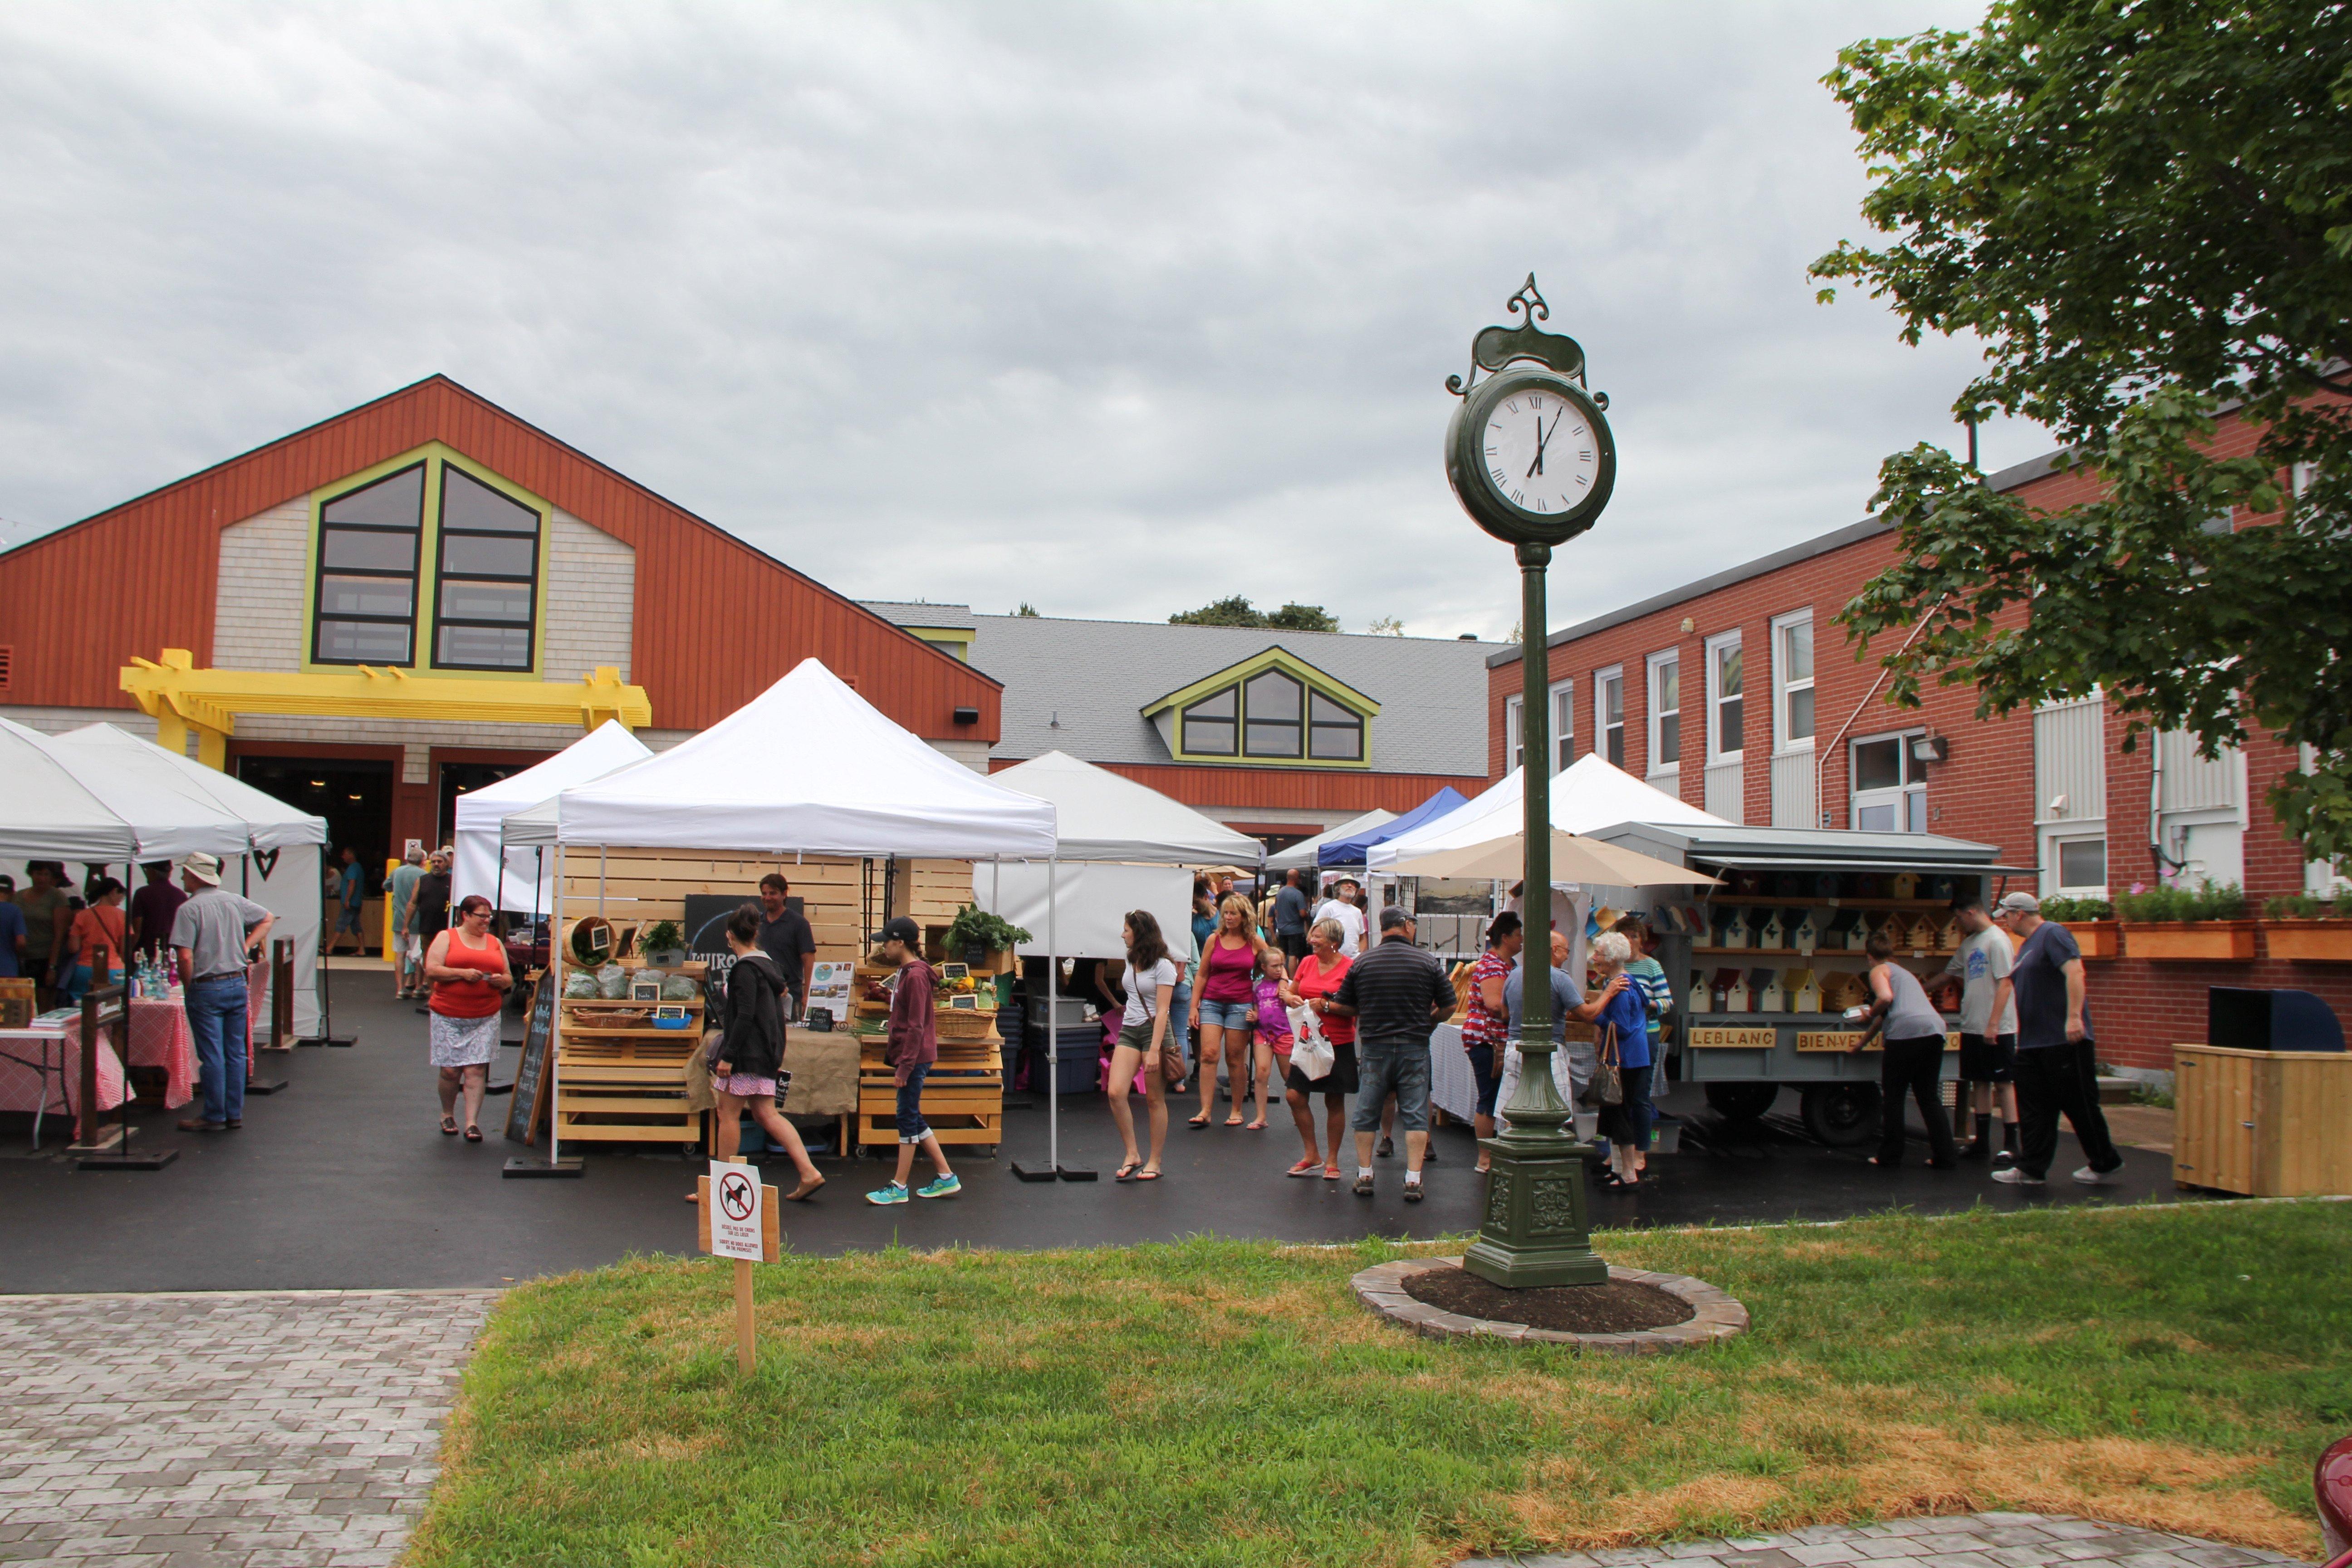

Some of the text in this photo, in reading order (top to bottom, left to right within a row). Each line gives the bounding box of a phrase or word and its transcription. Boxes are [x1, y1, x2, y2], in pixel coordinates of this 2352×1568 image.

[1506, 401, 1519, 416] XI
[1529, 397, 1542, 410] XII
[1572, 426, 1584, 436] II
[1579, 451, 1591, 462] III
[1693, 1031, 1772, 1045] LEBLANC
